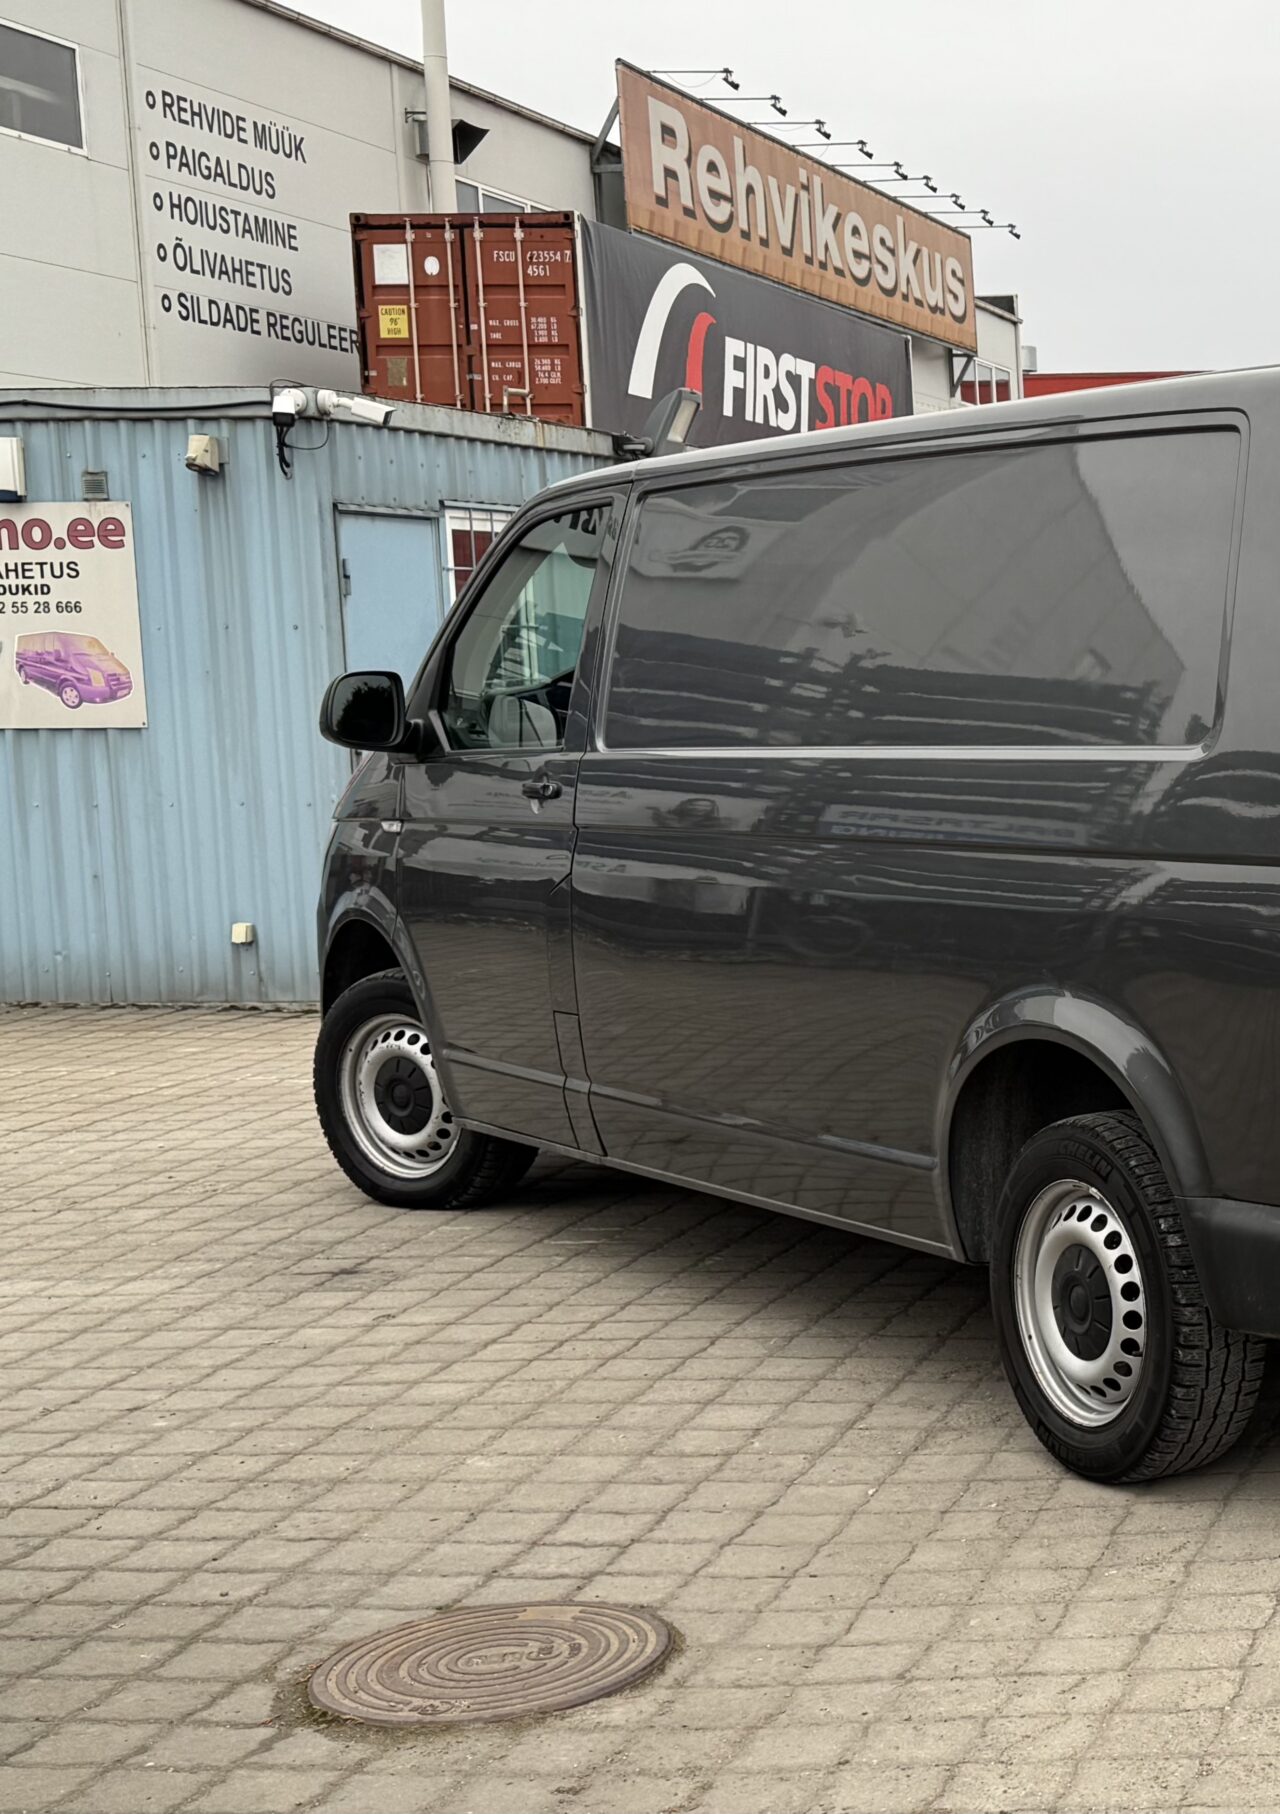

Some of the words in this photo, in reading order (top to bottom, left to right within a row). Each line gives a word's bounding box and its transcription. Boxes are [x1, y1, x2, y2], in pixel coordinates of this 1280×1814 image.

[161, 89, 248, 145] REHVIDE
[252, 120, 307, 164] MÜÜK
[165, 140, 276, 200] PAIGALDUS
[168, 191, 299, 252] HOIUSTAMINE
[647, 96, 967, 322] Rehvikeskus
[173, 237, 293, 296] ÕLIVAHETUS
[493, 250, 516, 262] FSCU
[177, 292, 261, 336] SILDADE
[380, 307, 406, 316] CAUTION
[11, 601, 29, 614] 55
[33, 601, 51, 614] 28
[55, 600, 82, 614] 666
